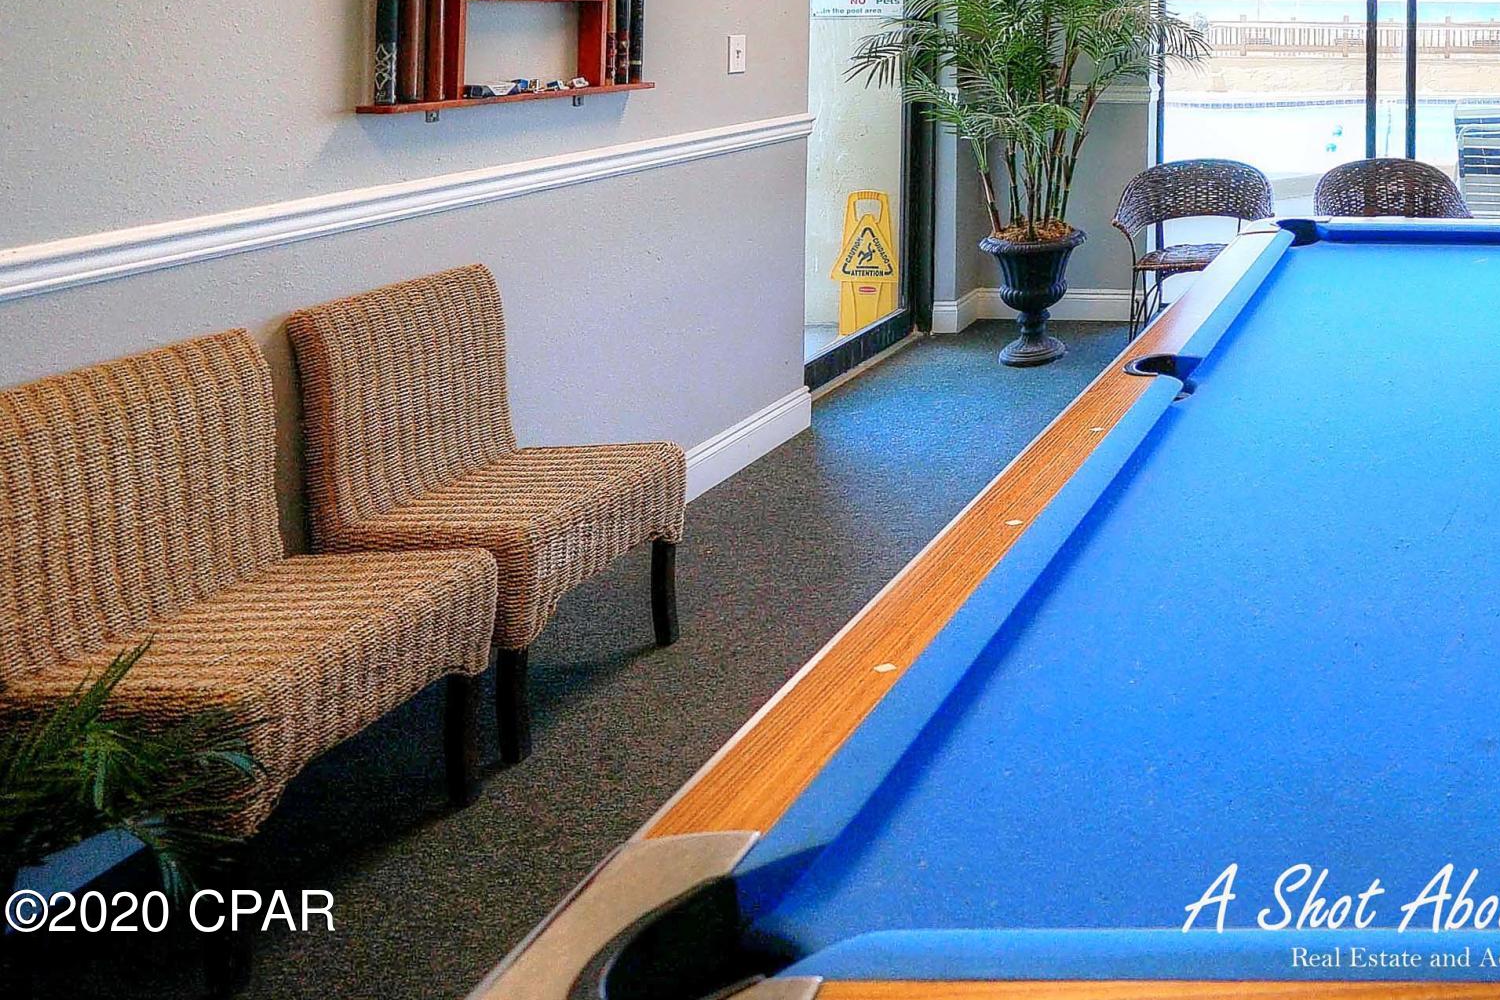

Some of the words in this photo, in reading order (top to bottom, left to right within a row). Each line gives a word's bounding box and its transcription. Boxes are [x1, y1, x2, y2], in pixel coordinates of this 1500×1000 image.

[846, 7, 863, 15] pool
[845, 236, 863, 264] CAUTION
[872, 237, 890, 264] CUIDADO
[850, 269, 884, 277] ATTENTION
